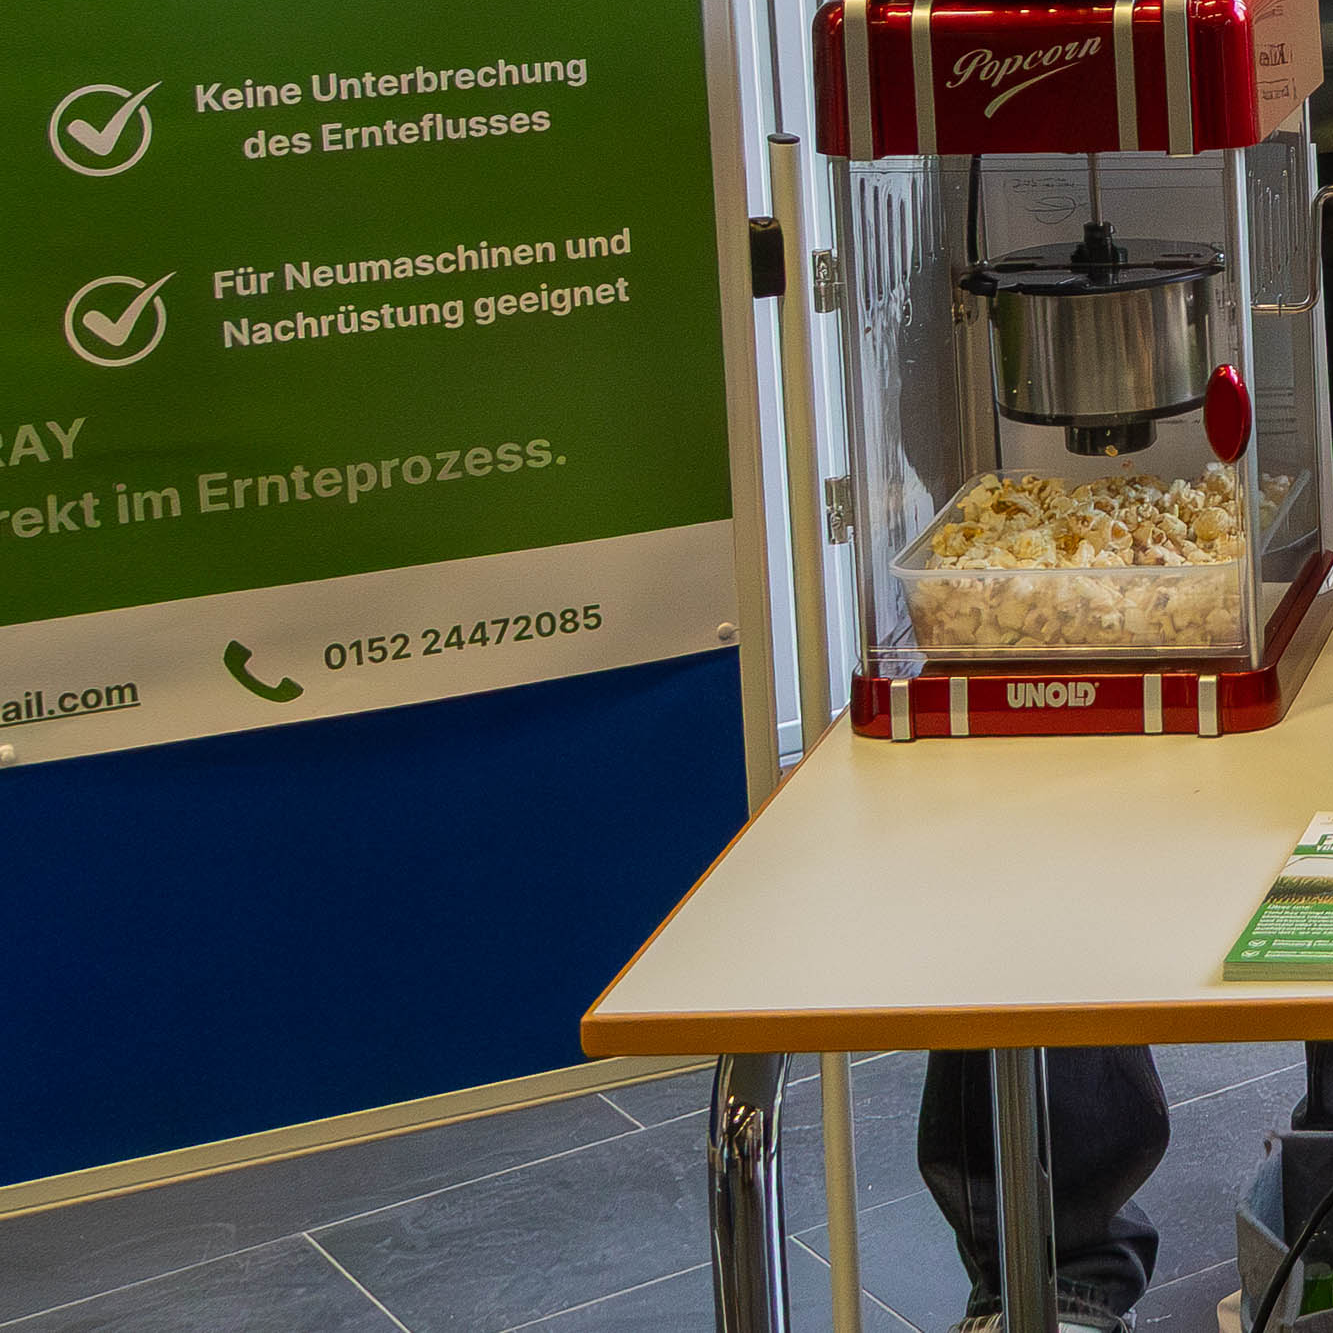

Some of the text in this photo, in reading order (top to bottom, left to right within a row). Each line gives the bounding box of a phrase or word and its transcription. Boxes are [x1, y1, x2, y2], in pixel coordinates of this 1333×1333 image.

[195, 57, 588, 112] Keine Unterbrechung
[946, 36, 1102, 88] Popcorn
[243, 108, 551, 159] des Ernteflusses
[214, 228, 631, 299] Für Neumaschinen und
[223, 277, 630, 348] Nachrüstung geeignet
[0, 418, 87, 466] AY
[116, 483, 181, 524] im
[200, 438, 567, 514] Ernteprozess.
[324, 605, 603, 671] 0152 24472085
[0, 680, 139, 723] ail.com
[1007, 682, 1096, 708] UNOLD
